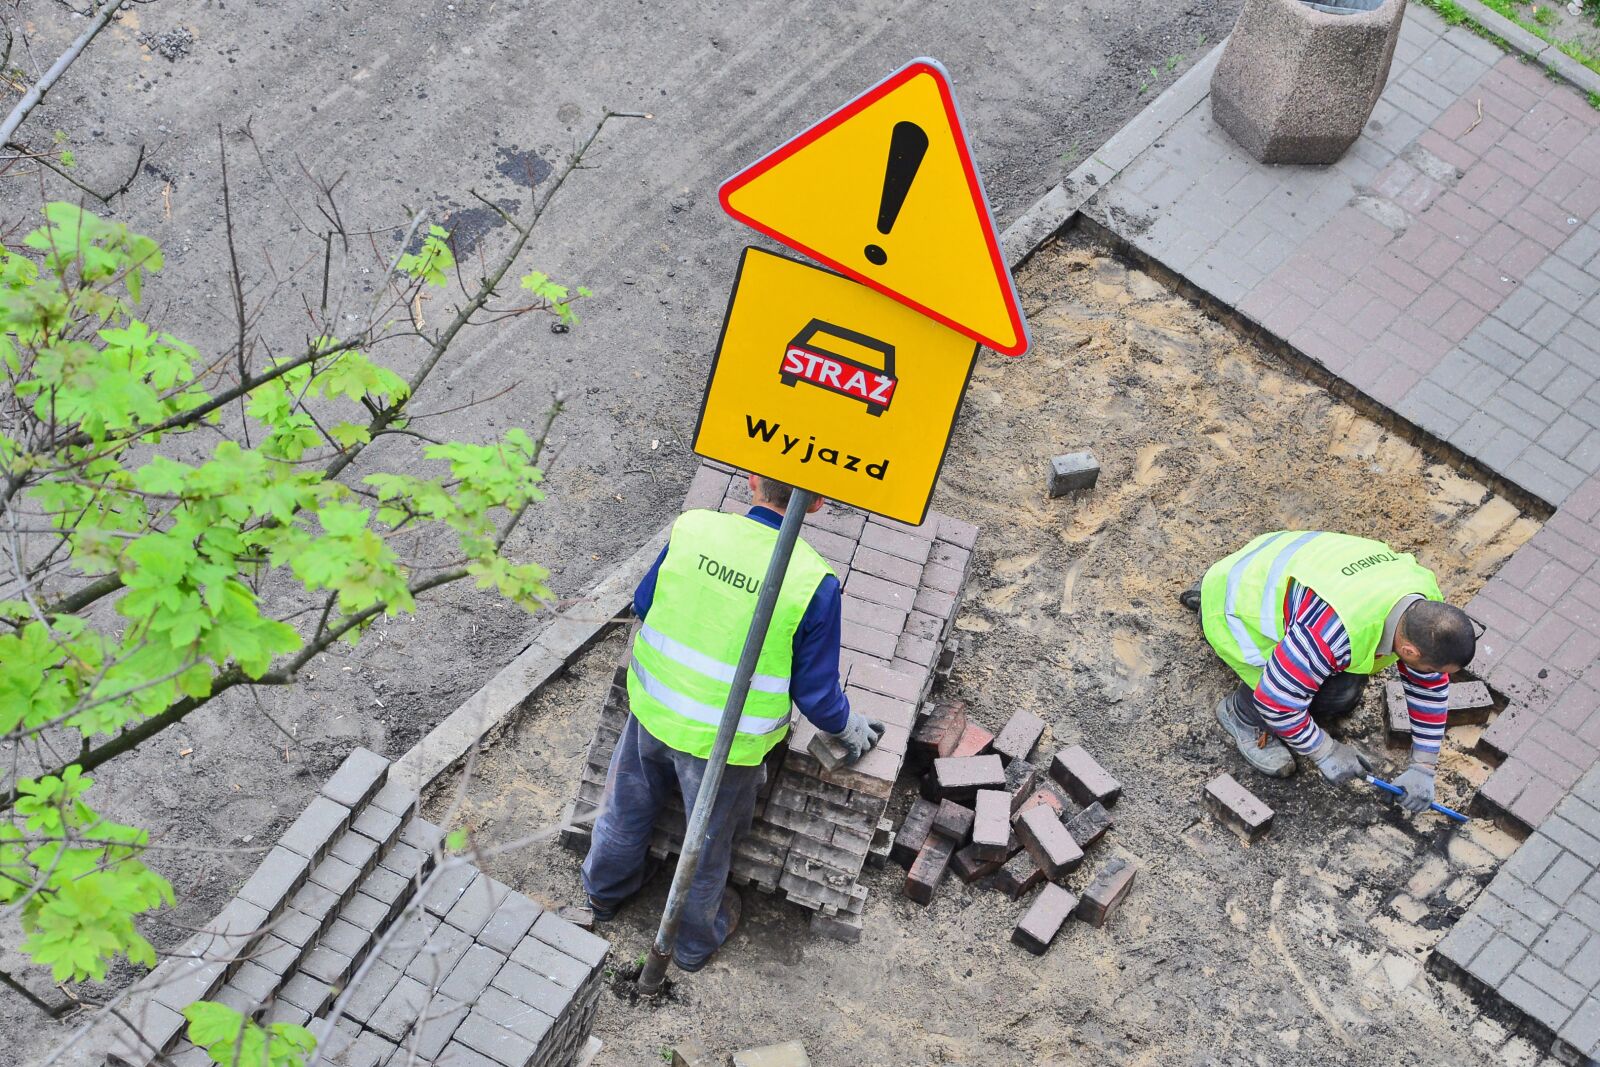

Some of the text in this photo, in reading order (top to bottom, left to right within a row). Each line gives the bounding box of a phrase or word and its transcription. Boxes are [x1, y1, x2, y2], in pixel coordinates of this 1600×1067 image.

[784, 349, 893, 403] STRAŻ
[745, 414, 890, 481] Wyjazd
[697, 553, 763, 597] TOMBU
[1341, 551, 1399, 576] TOMBUD
